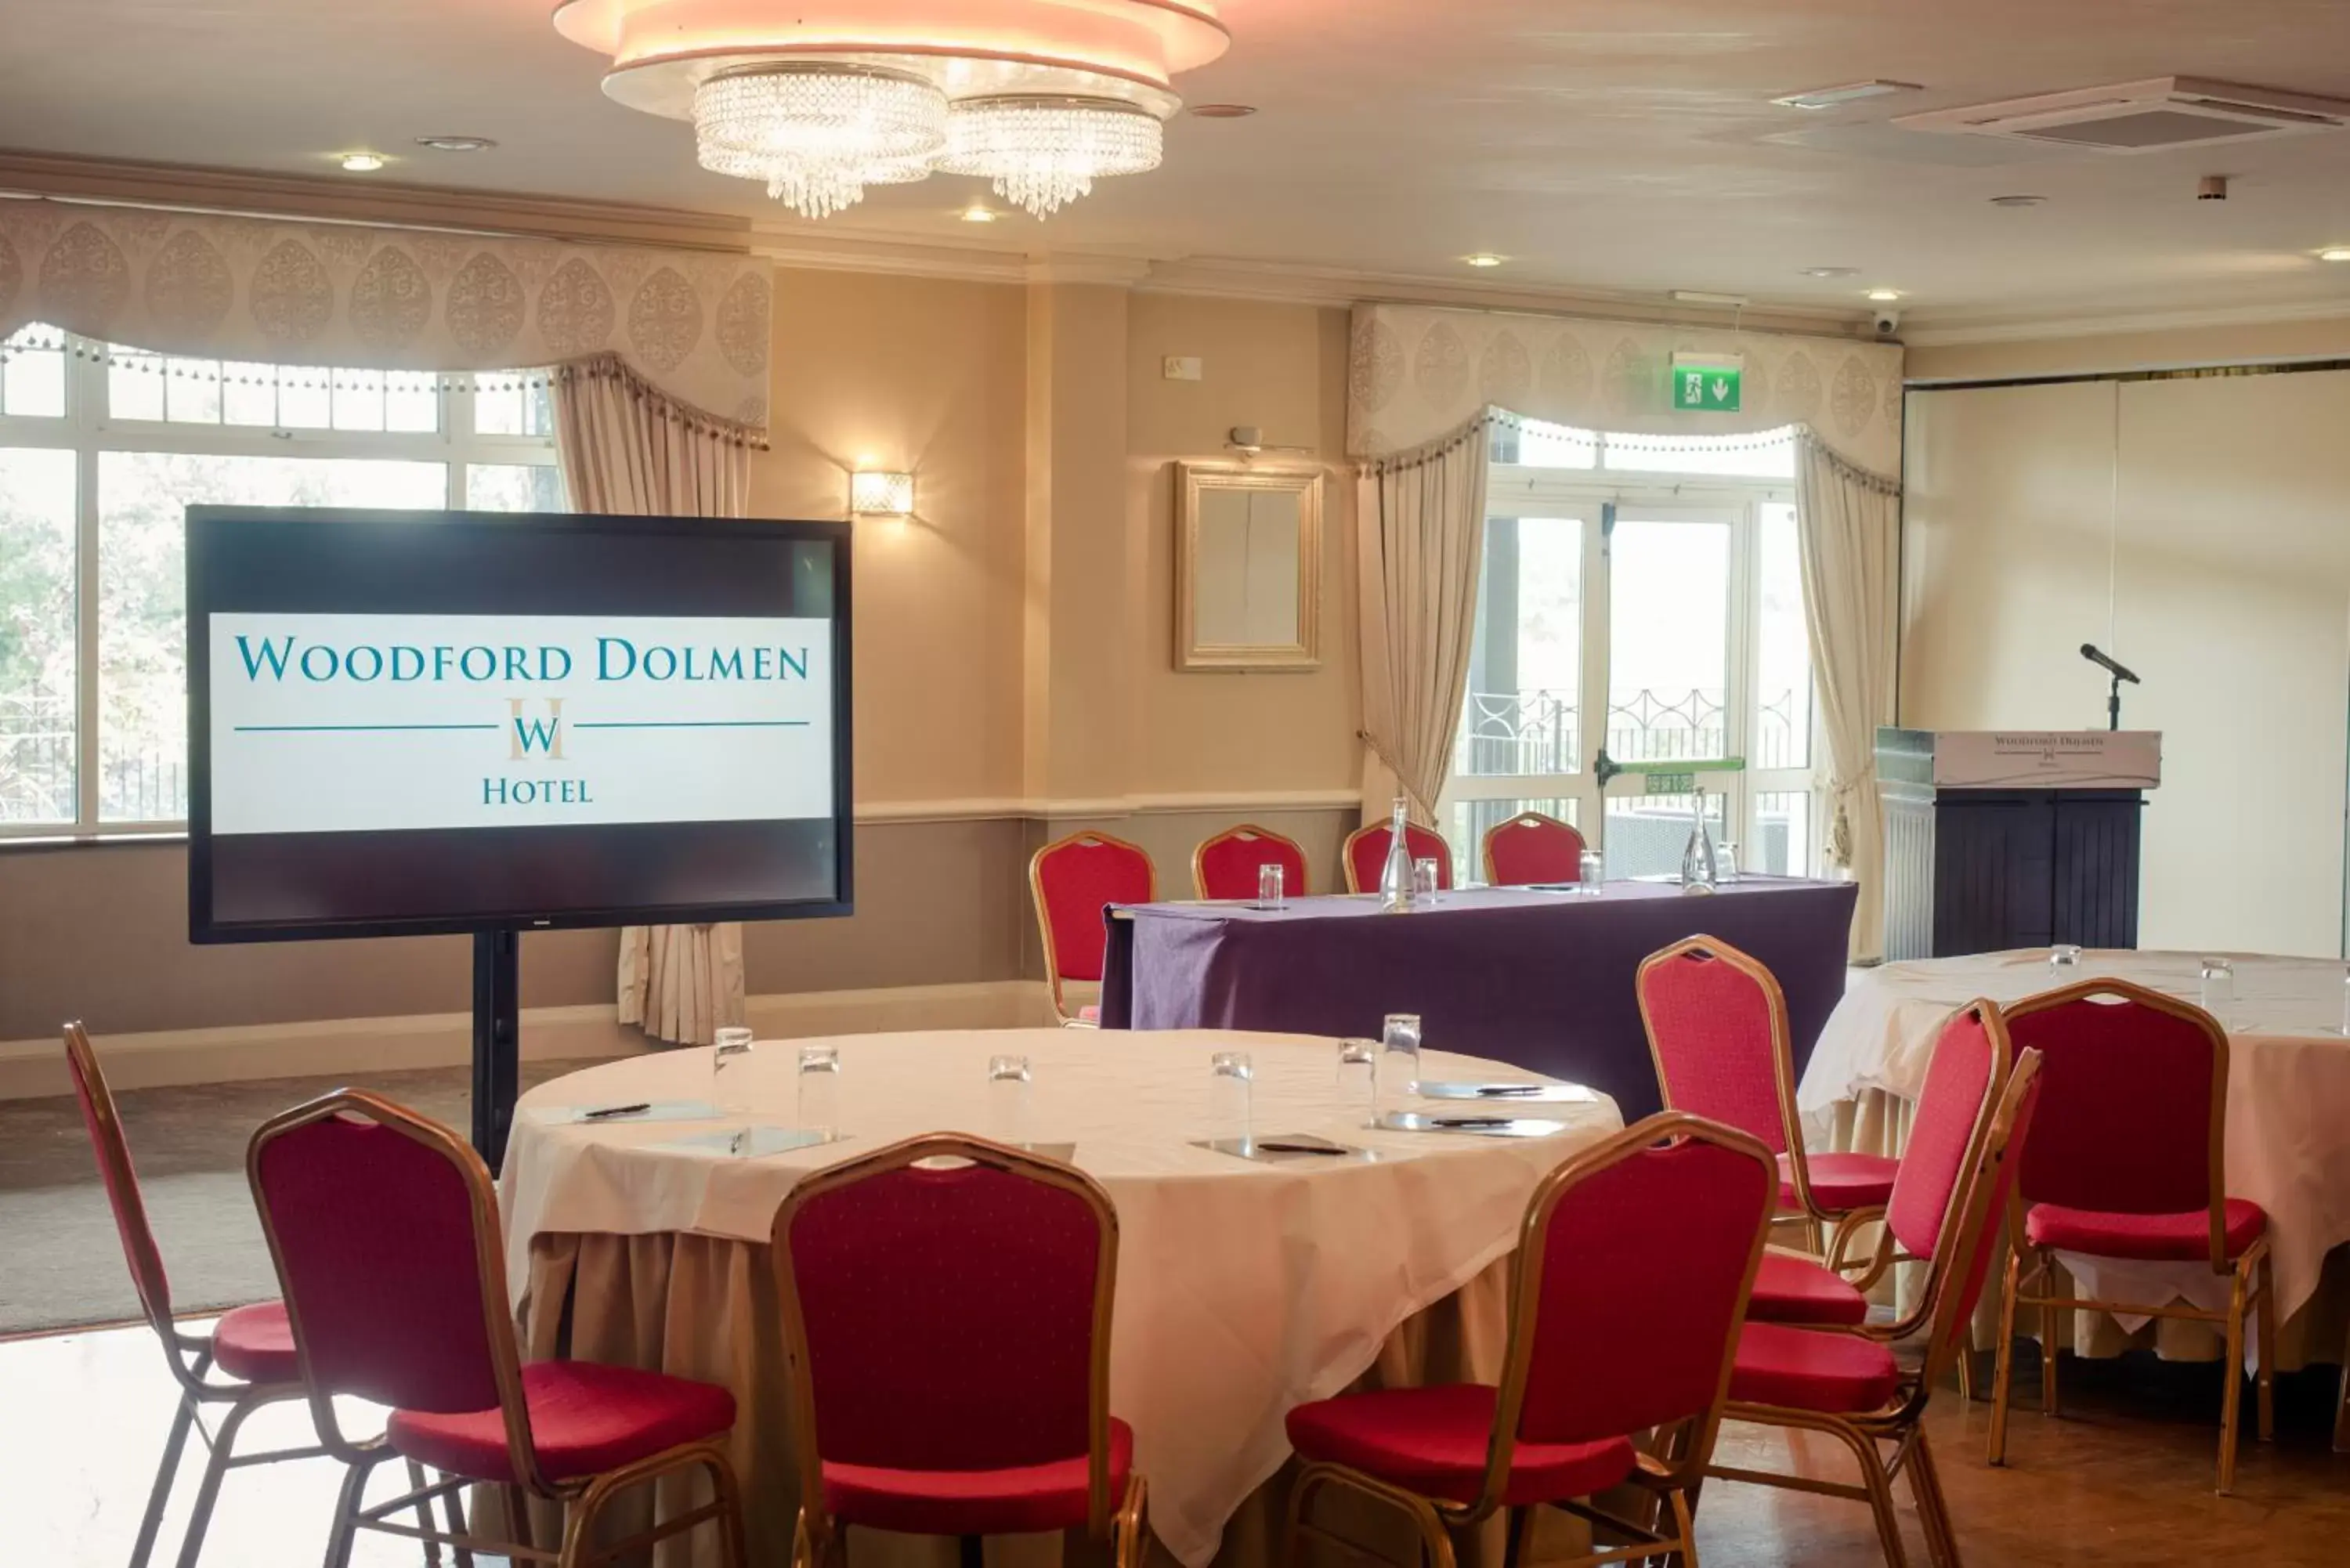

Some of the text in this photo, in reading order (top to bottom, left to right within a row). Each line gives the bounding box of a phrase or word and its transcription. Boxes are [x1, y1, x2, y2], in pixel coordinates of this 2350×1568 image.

[235, 634, 809, 682] WOODFORD DOLMEN
[483, 778, 593, 804] HOTEL
